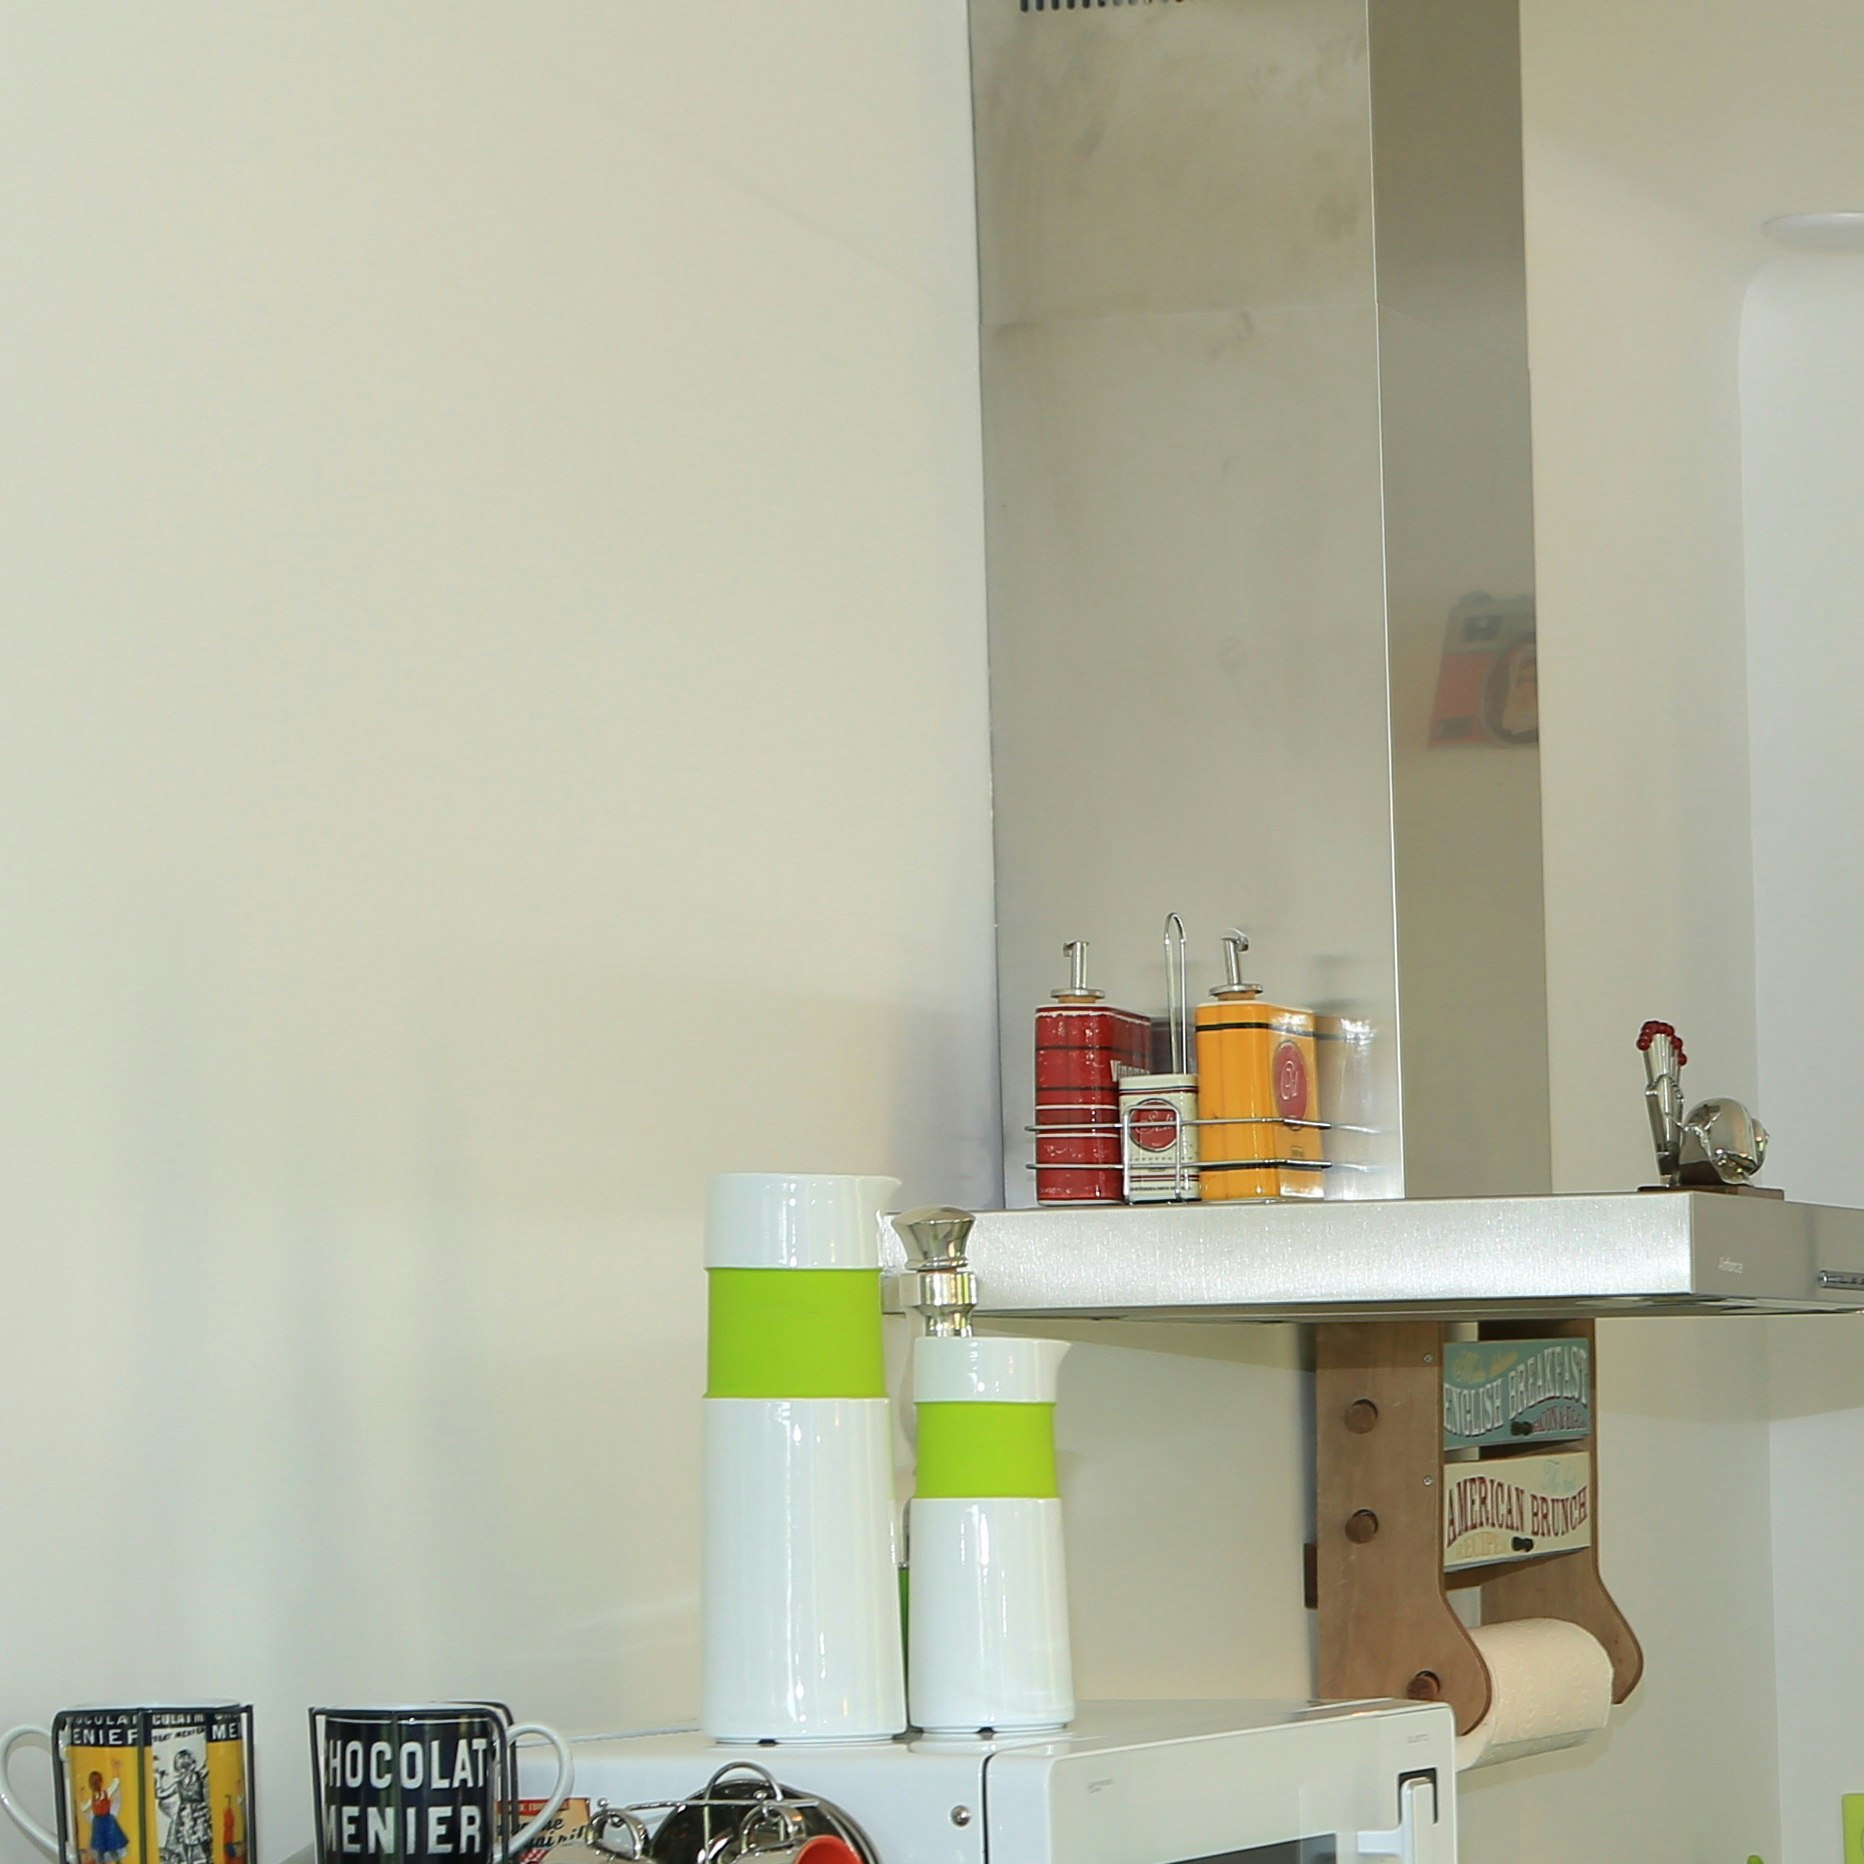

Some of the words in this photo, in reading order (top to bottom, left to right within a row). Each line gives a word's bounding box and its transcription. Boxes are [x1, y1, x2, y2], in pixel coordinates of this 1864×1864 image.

[1508, 1345, 1588, 1422] BREAKFAST
[1446, 1475, 1525, 1549] AMERICAN
[1530, 1485, 1588, 1537] BRUNCH
[329, 1738, 488, 1790] HOCOLAT
